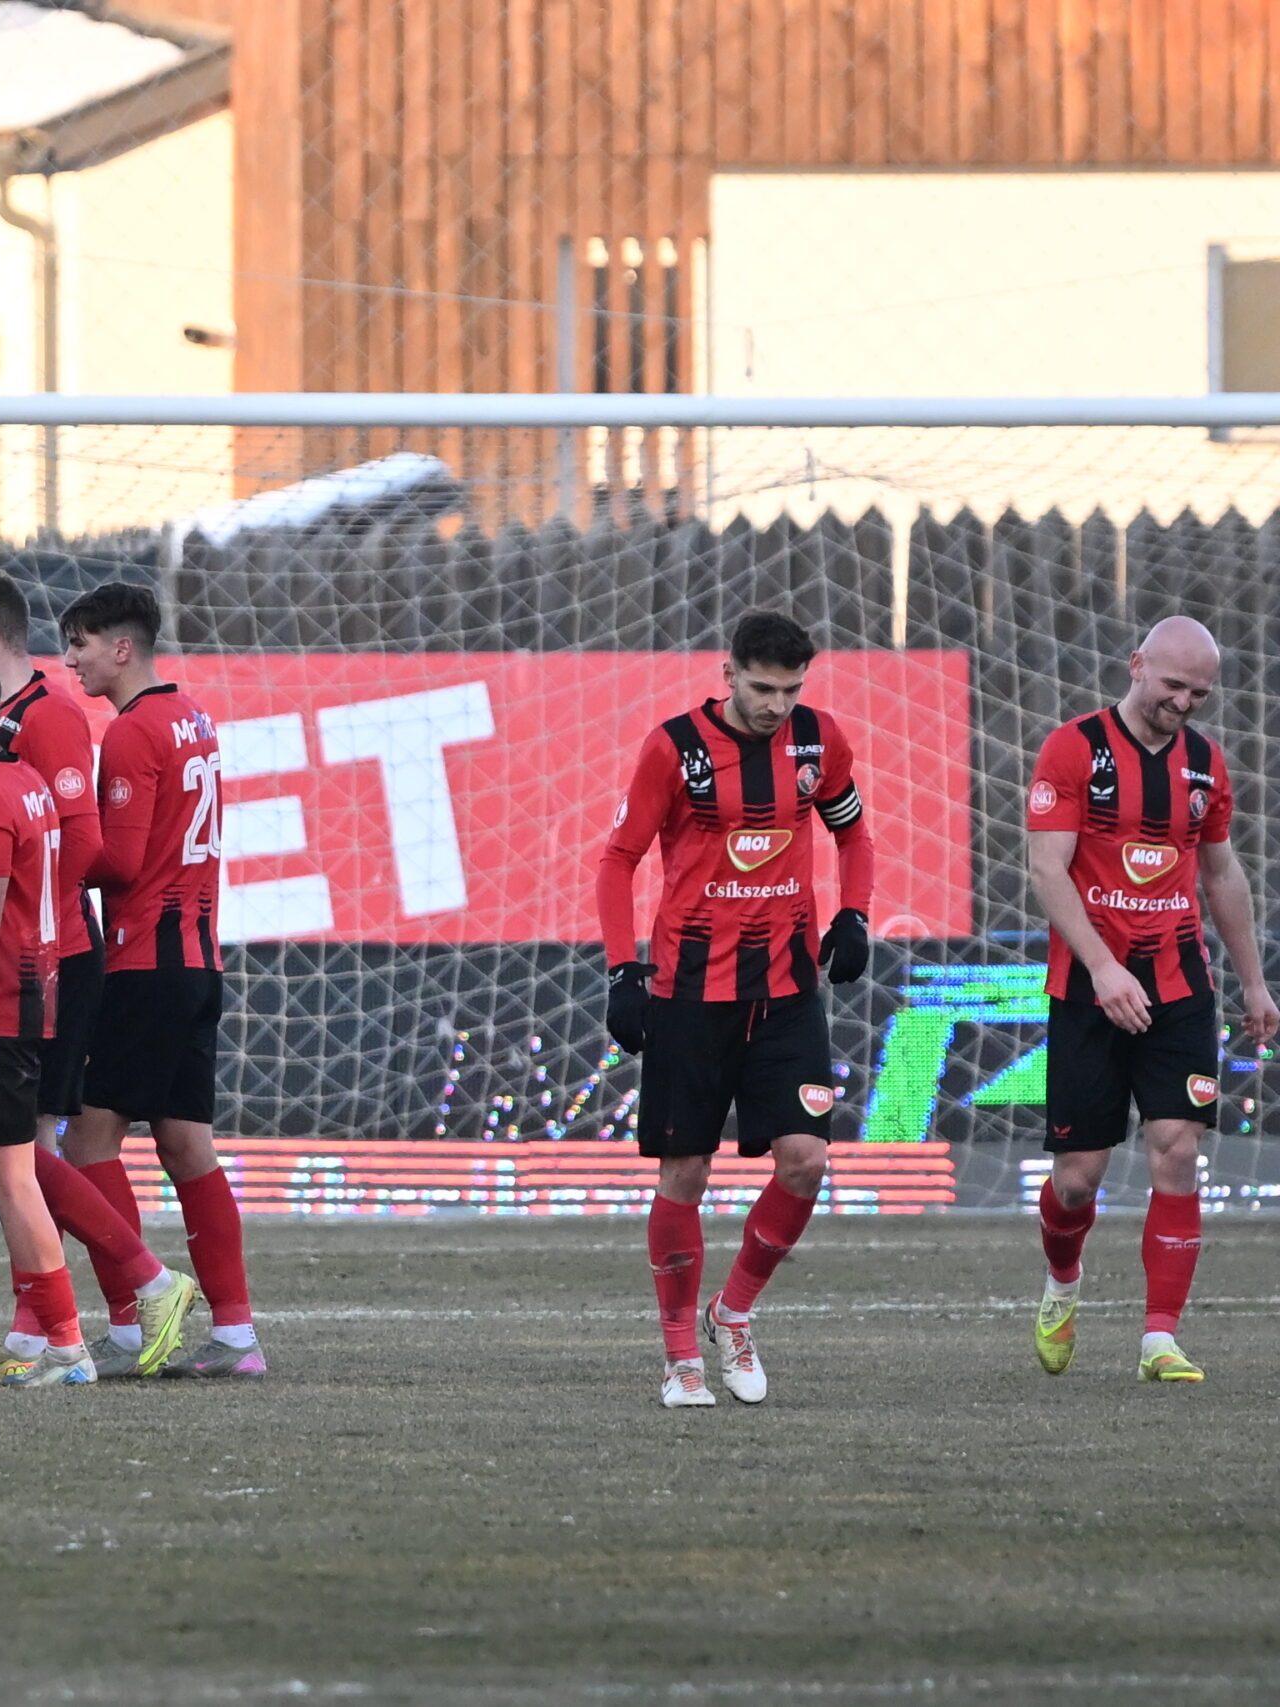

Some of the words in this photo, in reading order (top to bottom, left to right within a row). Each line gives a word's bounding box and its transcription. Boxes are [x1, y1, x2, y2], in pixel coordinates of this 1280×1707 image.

[182, 751, 222, 866] 20
[735, 835, 771, 851] MOL
[1130, 848, 1163, 866] MOL
[704, 877, 800, 898] Csíkszereda
[1087, 885, 1190, 912] Csíkszereda
